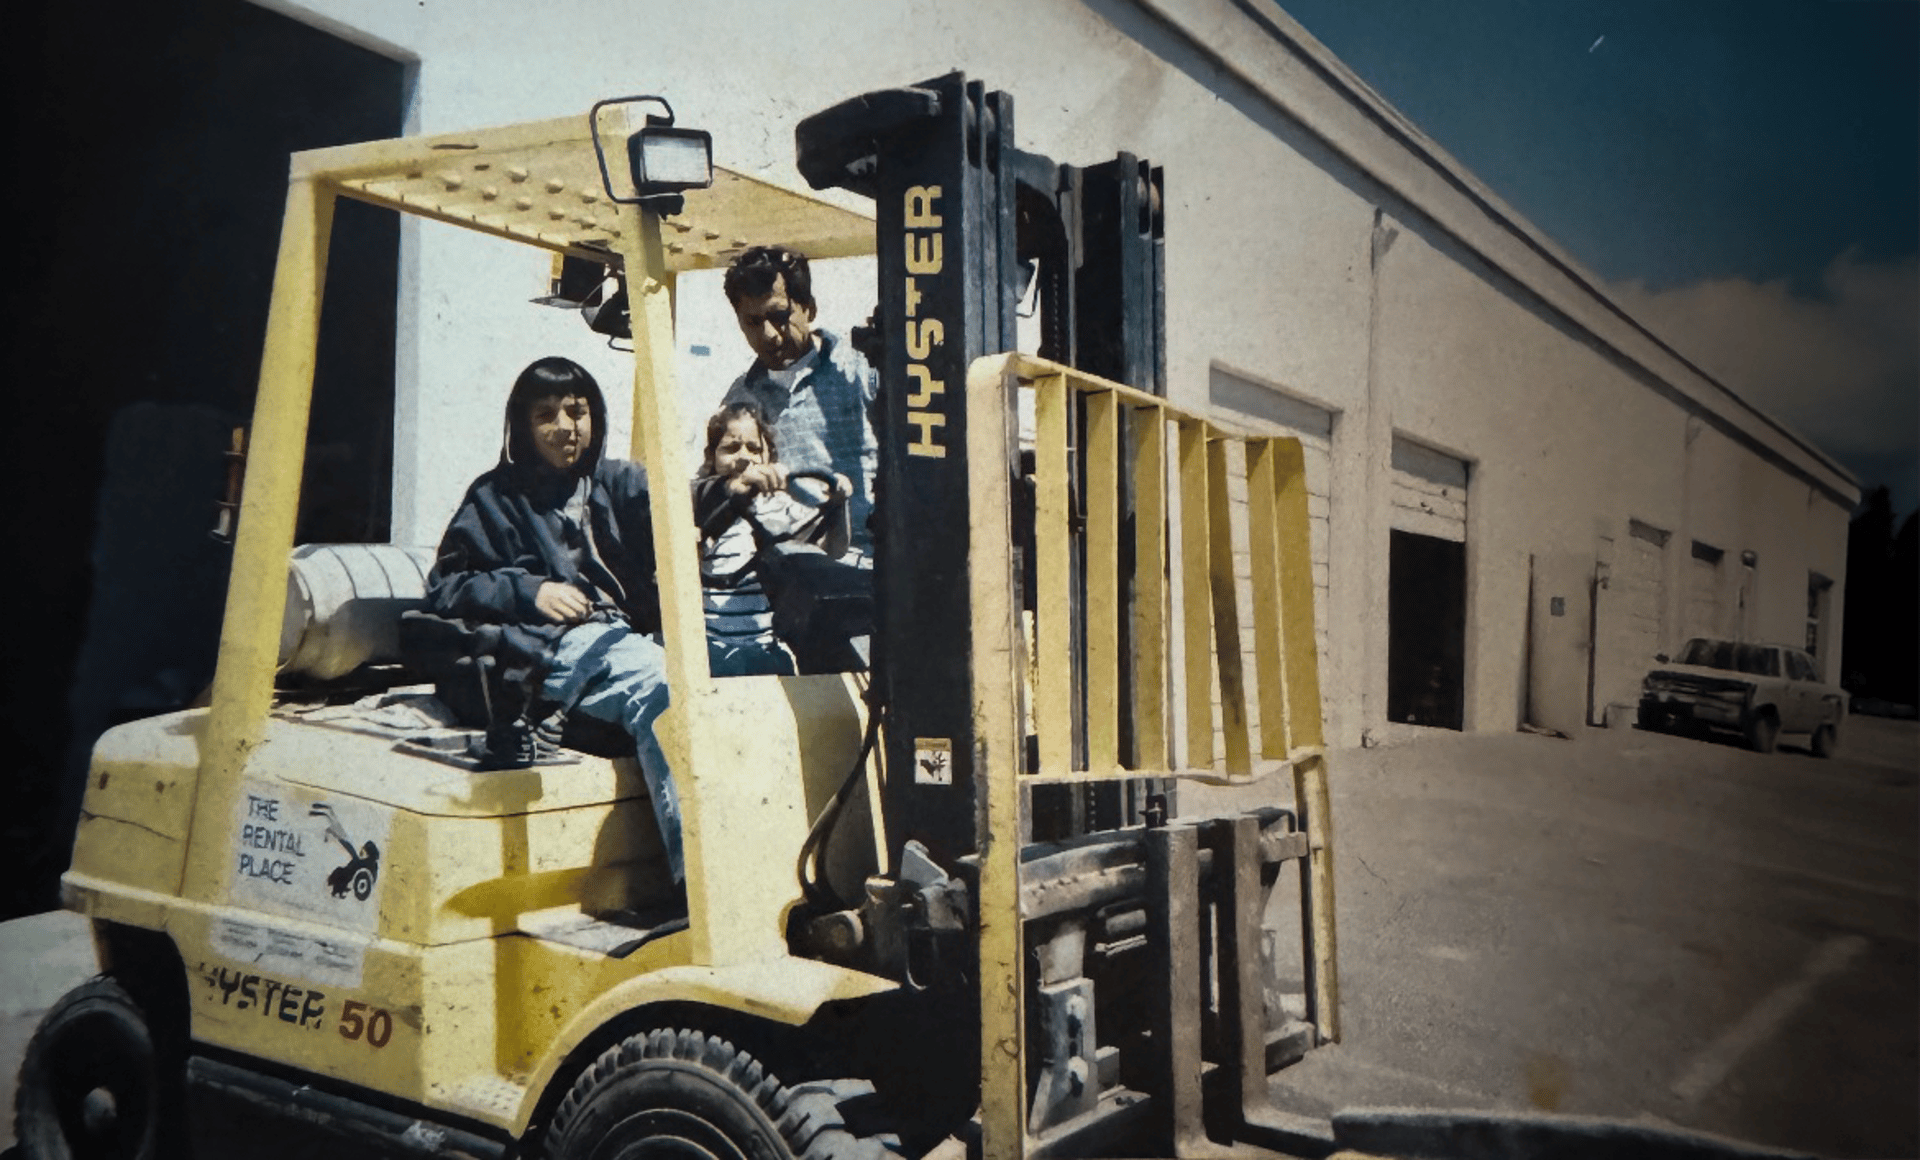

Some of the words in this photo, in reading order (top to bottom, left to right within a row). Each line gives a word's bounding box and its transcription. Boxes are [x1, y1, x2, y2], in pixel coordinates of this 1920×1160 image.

[904, 185, 946, 459] HYSTER
[248, 795, 279, 821] THE
[243, 823, 305, 857] RENTAL
[238, 852, 295, 885] PLACE
[339, 999, 392, 1048] 50
